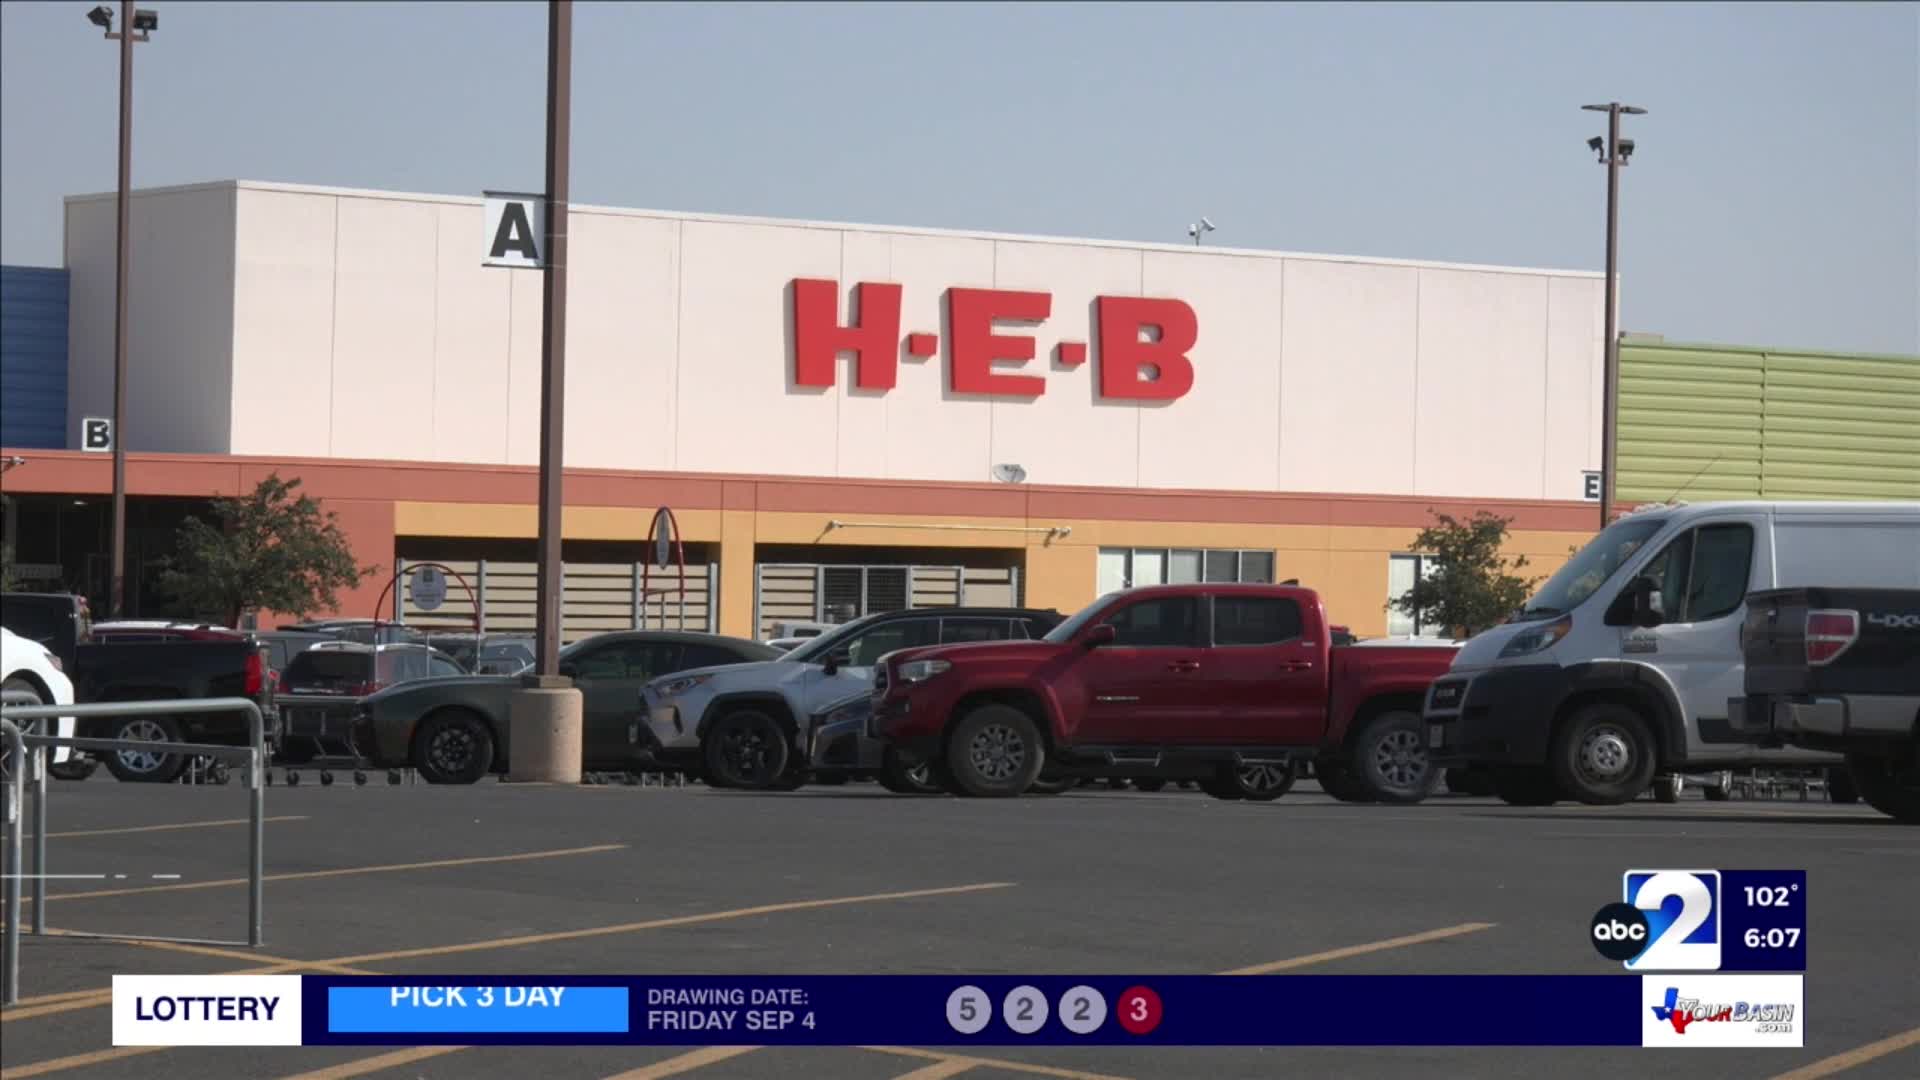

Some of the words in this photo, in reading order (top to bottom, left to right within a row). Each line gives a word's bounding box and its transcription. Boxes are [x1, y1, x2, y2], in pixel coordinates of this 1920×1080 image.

[489, 202, 539, 259] A
[790, 278, 1198, 402] H-E-B
[86, 420, 110, 448] B
[1585, 475, 1599, 498] E
